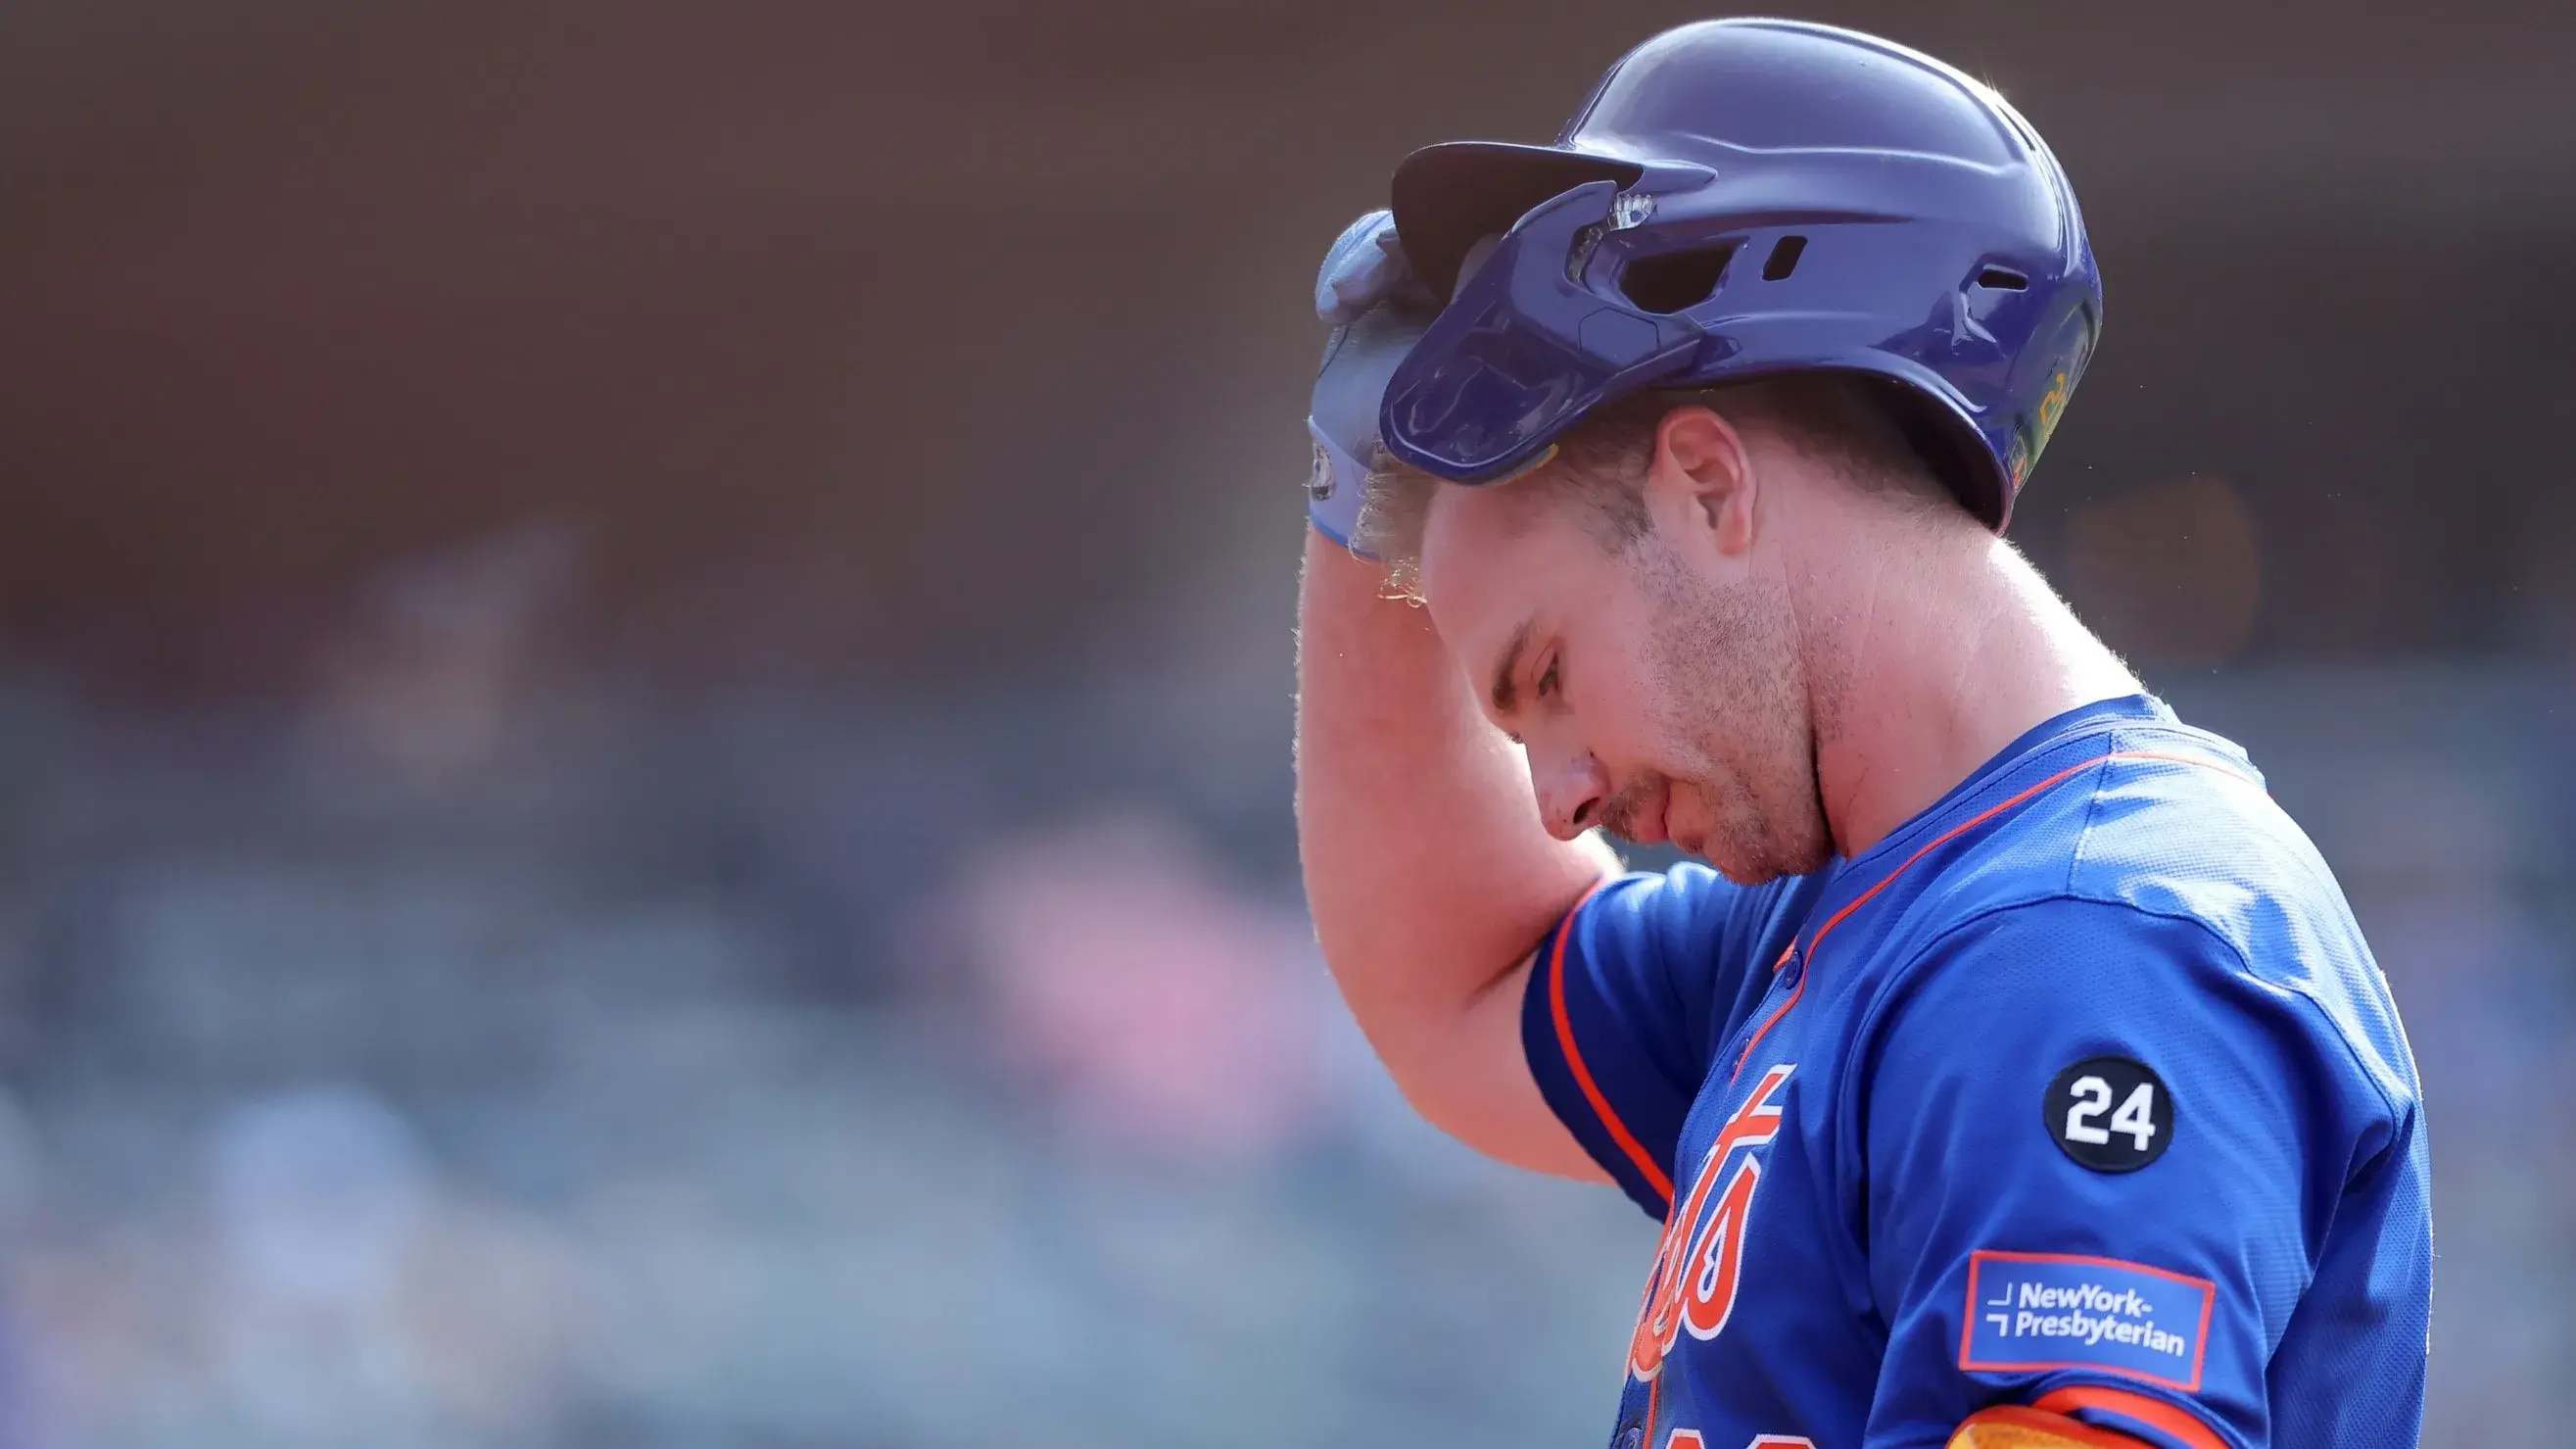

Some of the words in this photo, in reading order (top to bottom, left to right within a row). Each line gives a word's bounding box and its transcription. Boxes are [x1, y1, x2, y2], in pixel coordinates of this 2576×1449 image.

[2065, 1075, 2157, 1151] 24
[1623, 1063, 1798, 1382] ets
[2018, 1281, 2154, 1318] NewYork-
[2015, 1309, 2186, 1357] Presbyterian
